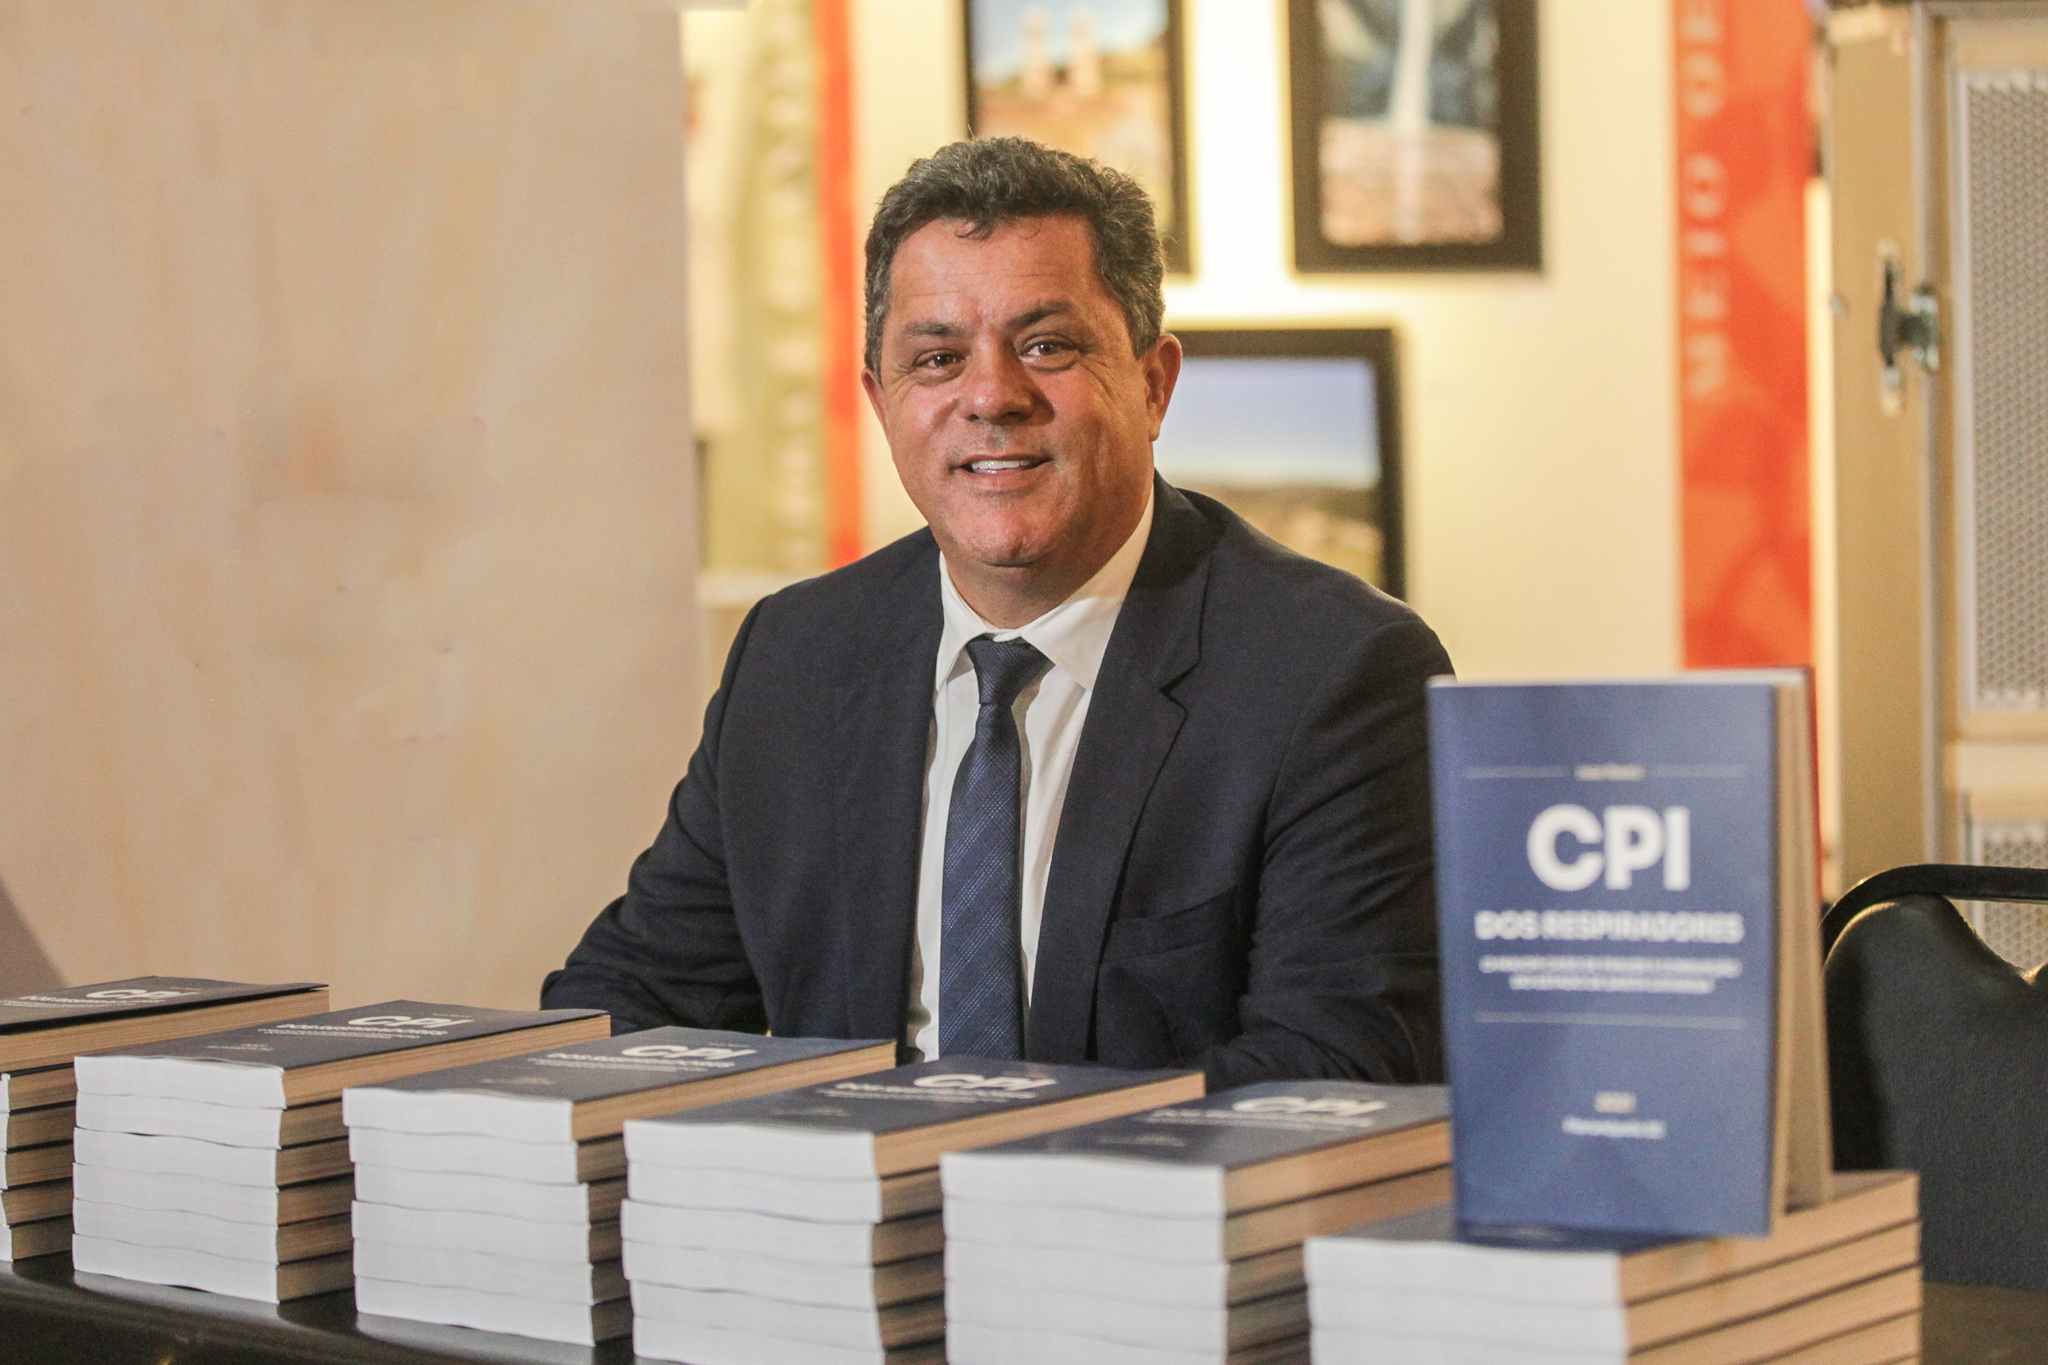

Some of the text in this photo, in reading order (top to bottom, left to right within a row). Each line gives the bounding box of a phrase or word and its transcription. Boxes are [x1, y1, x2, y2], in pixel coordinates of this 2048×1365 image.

[1526, 804, 1691, 892] CPI
[1475, 910, 1538, 940] DOS
[348, 1015, 475, 1028] CPI
[622, 1045, 757, 1060] CPI
[914, 1073, 1056, 1091] CPI
